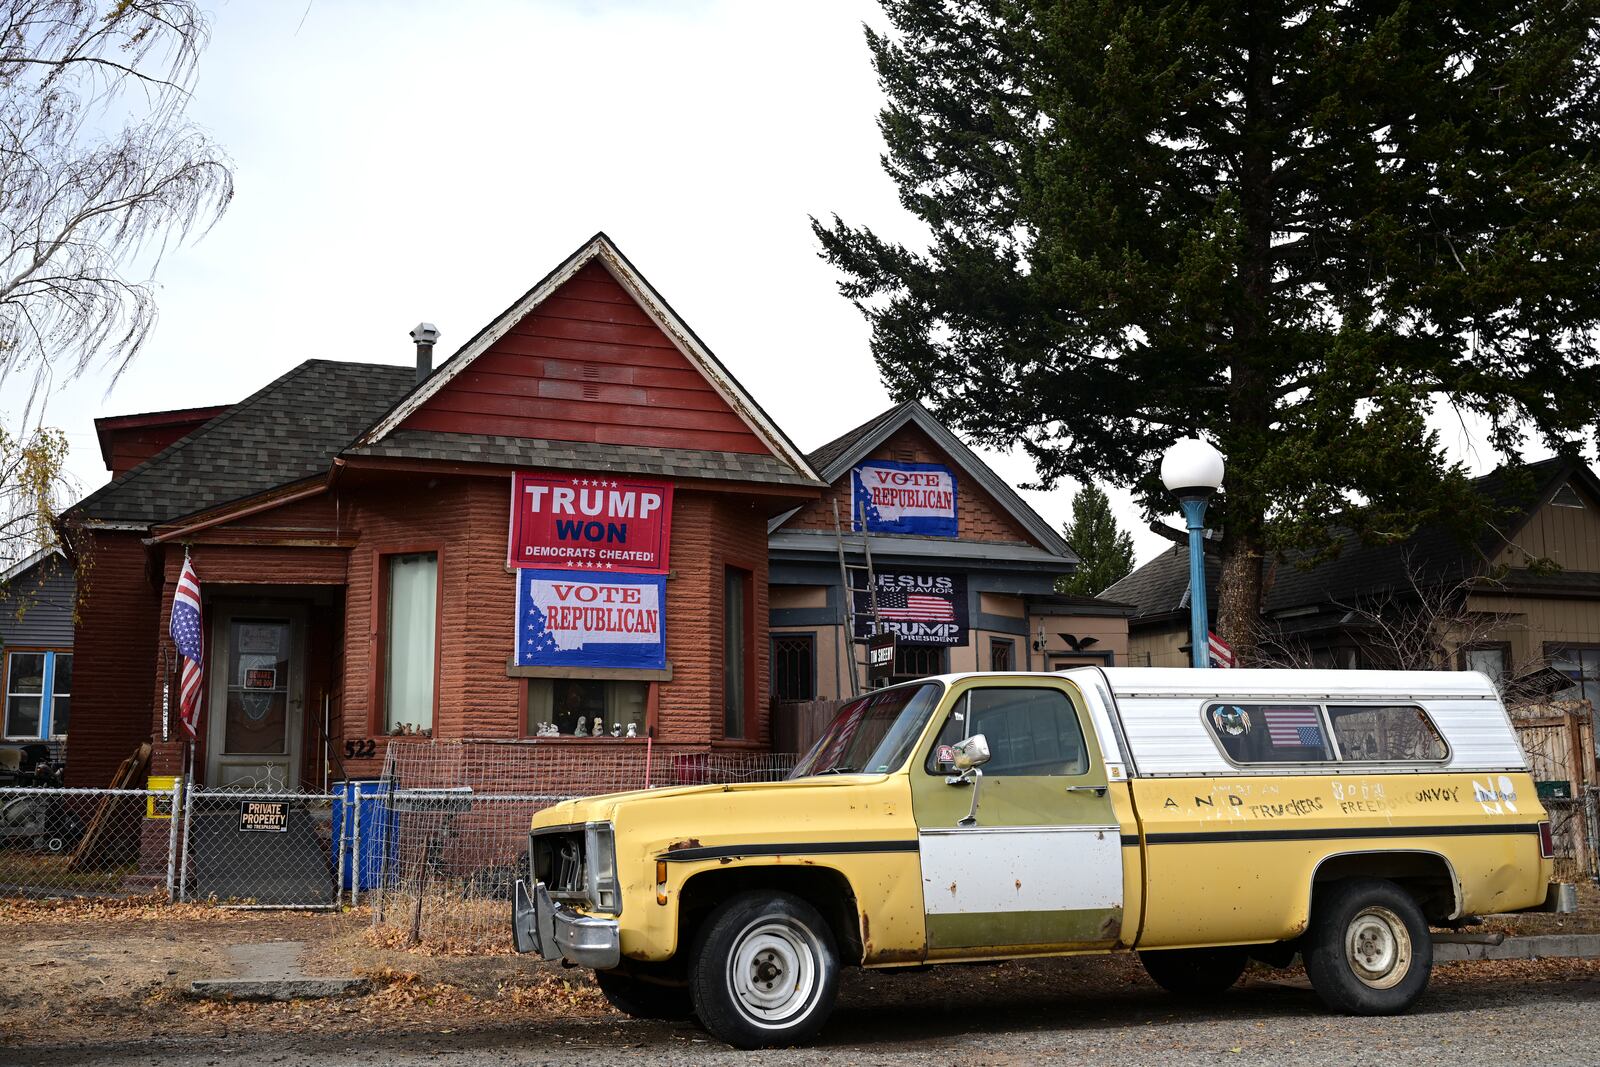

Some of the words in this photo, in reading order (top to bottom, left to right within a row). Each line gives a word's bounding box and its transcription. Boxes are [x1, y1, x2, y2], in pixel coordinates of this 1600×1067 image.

[874, 470, 939, 487] VOTE
[525, 486, 661, 519] TRUMP
[872, 487, 952, 510] REPUBLICAN
[556, 519, 627, 544] WON
[525, 546, 596, 558] DEMOCRATS
[599, 550, 654, 562] CHEATED!
[551, 584, 641, 605] VOTE
[907, 586, 953, 594] SAVIOR
[546, 605, 658, 633] REPUBLICAN
[866, 621, 959, 637] TRUMP
[900, 635, 959, 643] PRESIDENT
[344, 739, 375, 759] 522
[249, 803, 282, 815] PRIVATE
[1164, 794, 1243, 808] AND
[1249, 797, 1324, 818] TRUCKERS
[242, 813, 286, 825] PROPERTY
